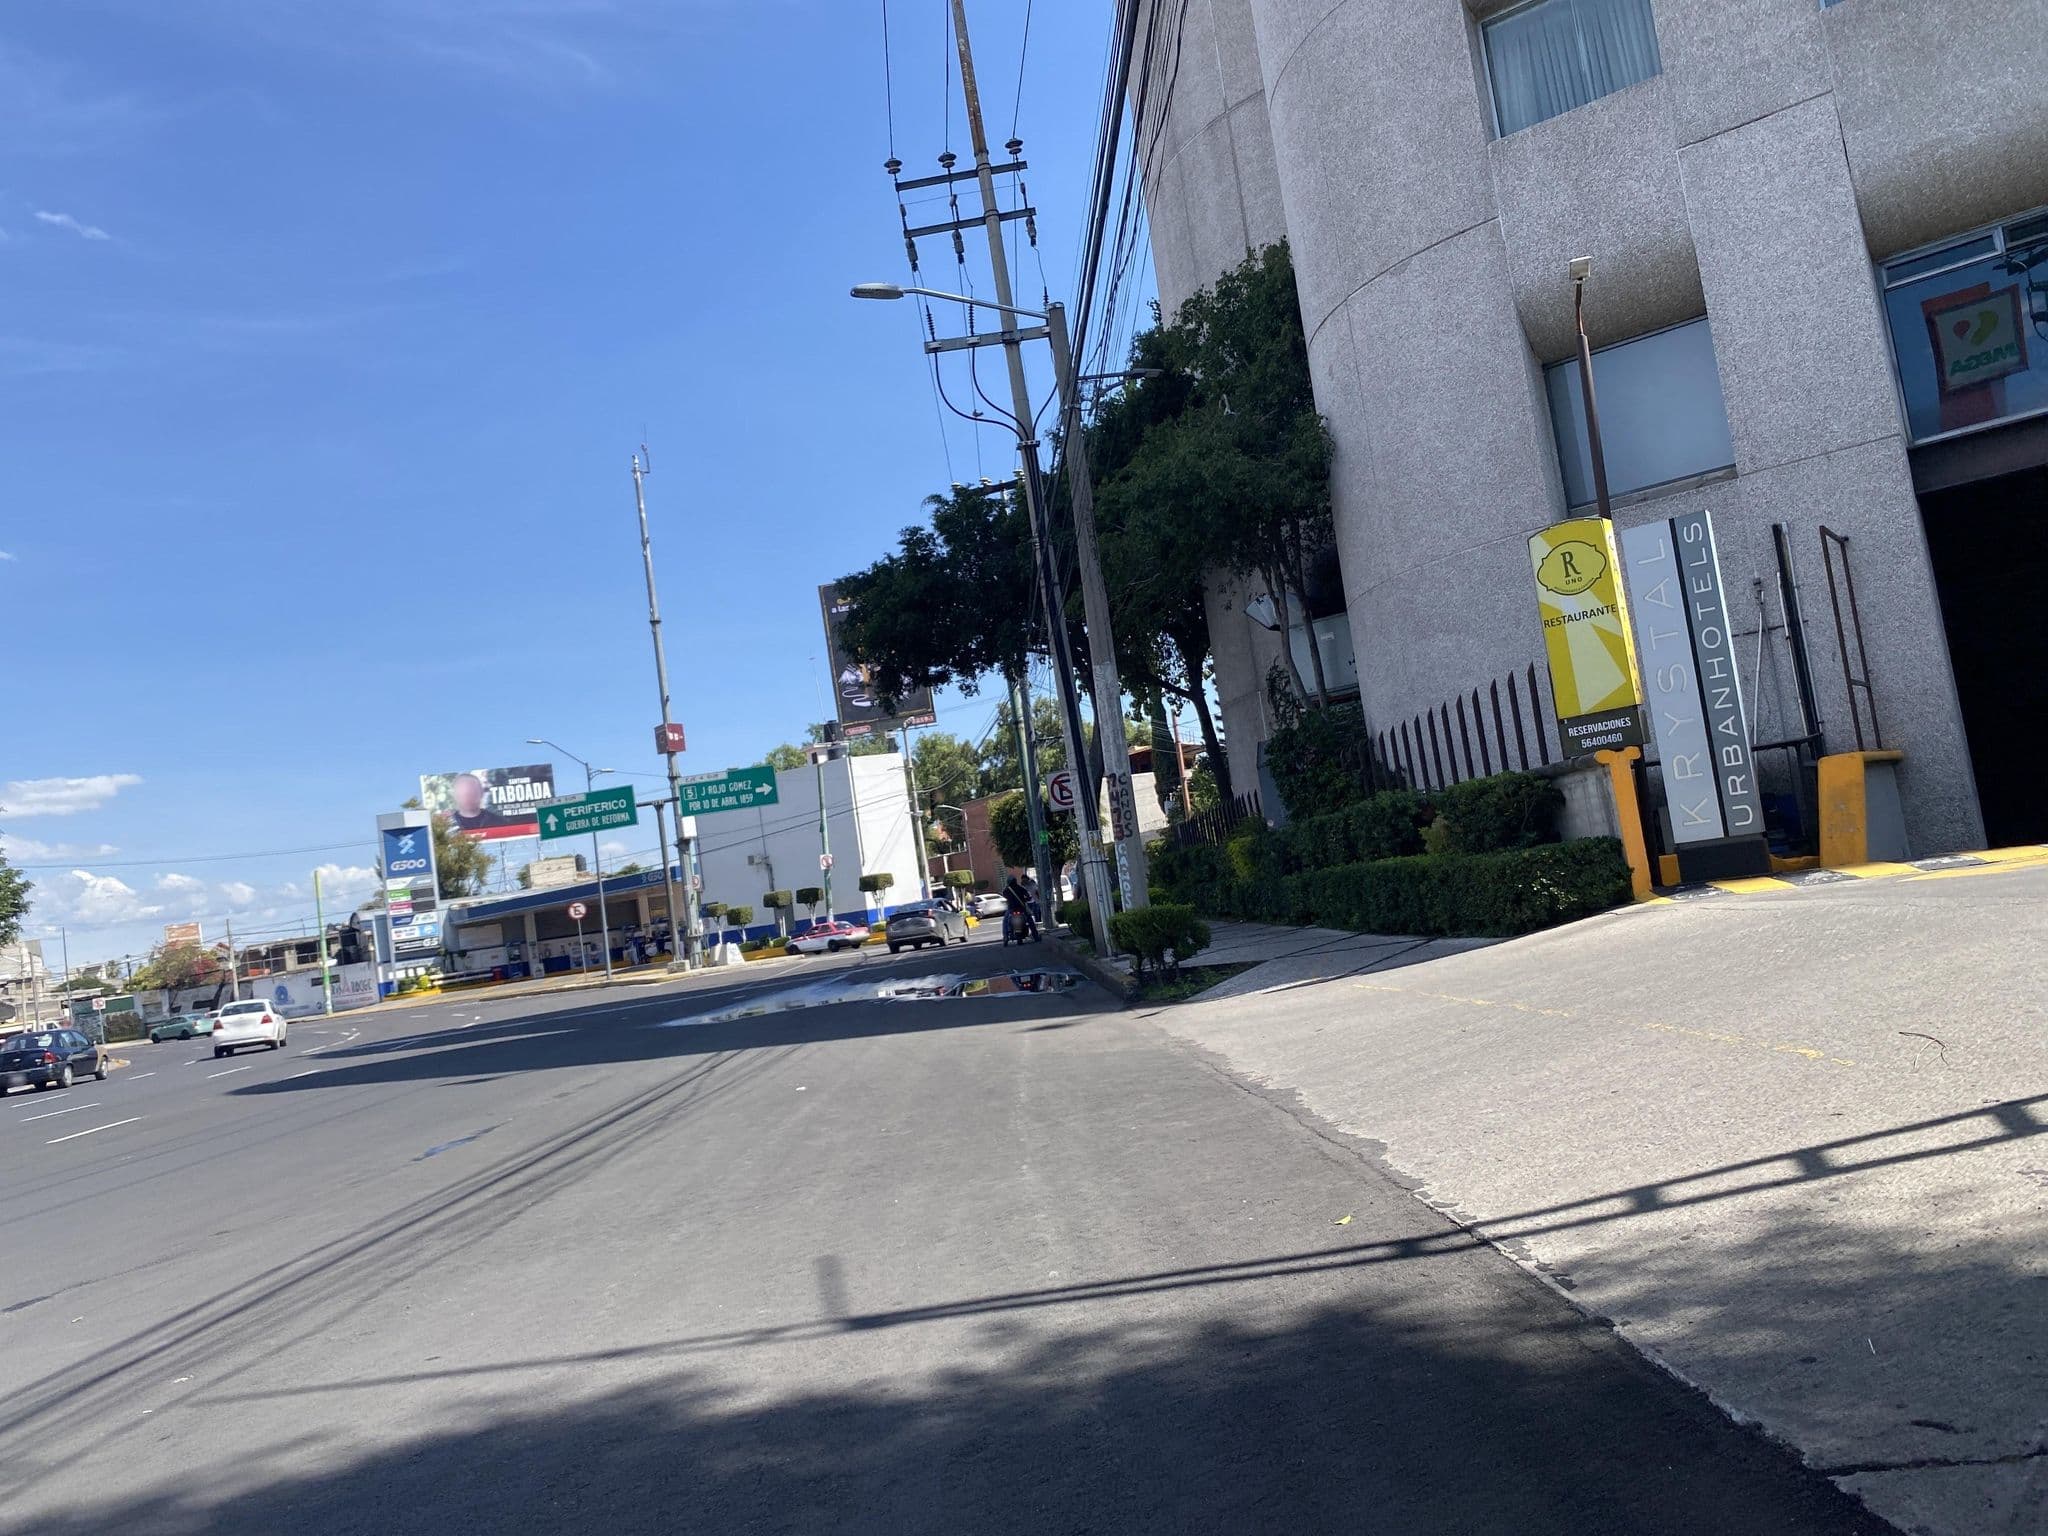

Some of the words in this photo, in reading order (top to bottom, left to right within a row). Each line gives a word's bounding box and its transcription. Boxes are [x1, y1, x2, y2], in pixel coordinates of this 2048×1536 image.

[1560, 550, 1581, 578] R
[1565, 577, 1583, 585] UNO
[1543, 602, 1617, 629] RESTAURANTE
[1638, 538, 1712, 828] KRYSTAL
[1567, 716, 1632, 737] RESERVACIONES
[1580, 733, 1623, 749] 56400460
[489, 781, 552, 804] TABOADA
[686, 788, 694, 798] 5
[700, 786, 706, 796] J
[707, 783, 727, 796] ROJO
[728, 780, 753, 794] GOMEZ
[563, 799, 627, 818] PERIFERICO
[688, 801, 701, 812] POR
[702, 800, 710, 810] 10
[710, 799, 720, 809] DE
[720, 796, 740, 808] ABRIL
[565, 816, 591, 832] GUERRA
[591, 815, 600, 827] DE
[601, 811, 631, 825] REFORMA
[390, 858, 427, 872] G500
